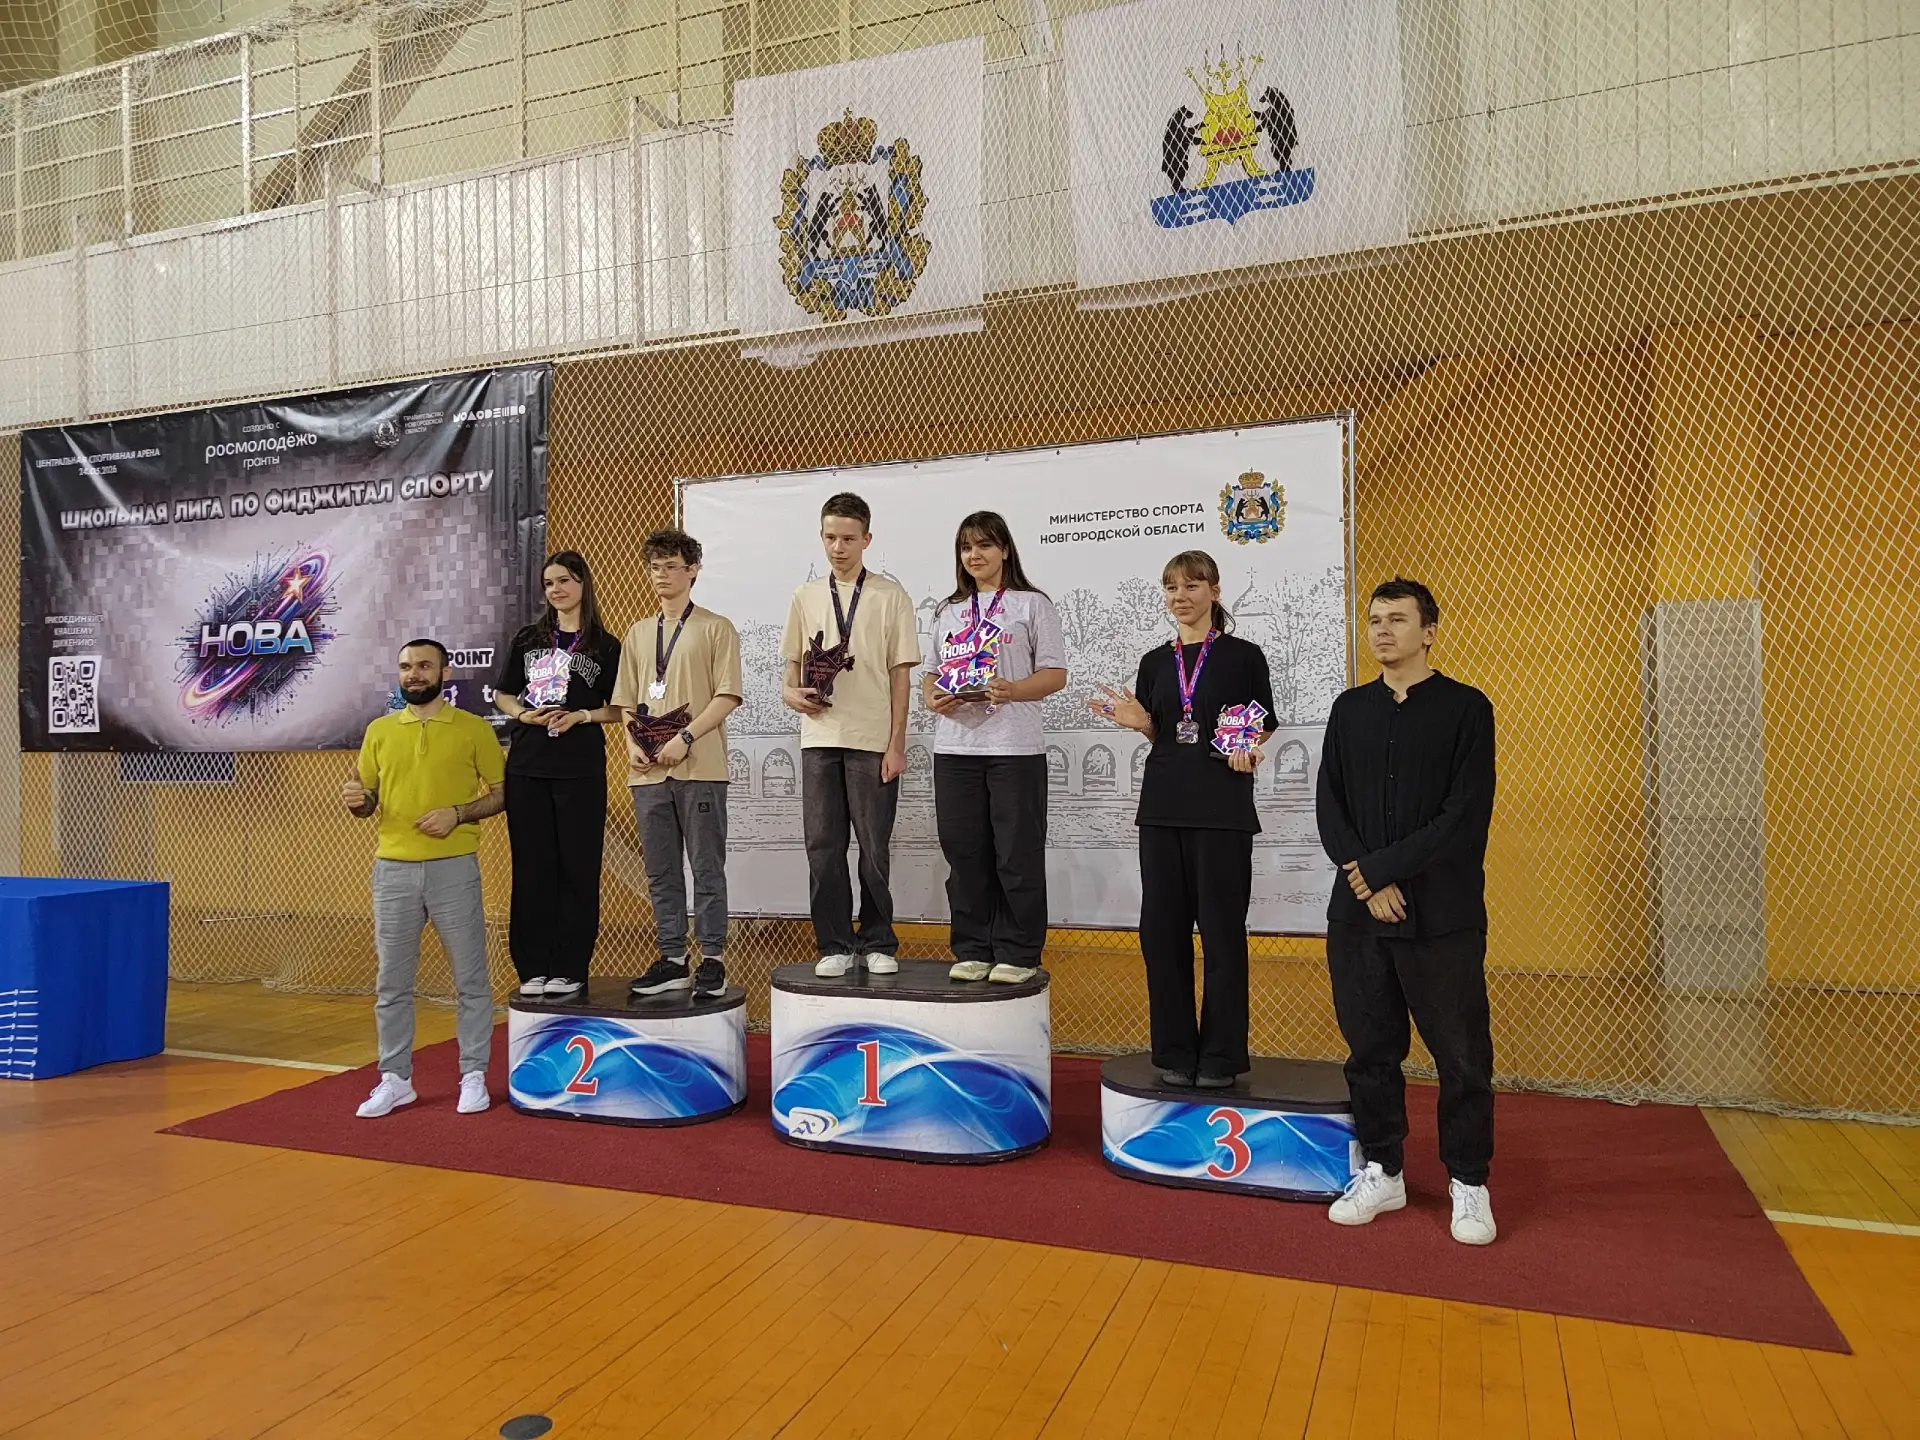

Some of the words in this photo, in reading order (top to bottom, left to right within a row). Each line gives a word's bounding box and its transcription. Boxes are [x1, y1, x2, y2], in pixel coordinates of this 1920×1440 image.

[242, 423, 274, 433] создано
[36, 455, 87, 468] ЦЕНТРАЛЬНАЯ
[88, 450, 136, 464] СПОРТИВНАЯ
[136, 447, 160, 459] АРЕНА
[205, 432, 318, 464] росмолодёжь
[243, 455, 280, 470] гранты
[60, 502, 169, 530] ШКОЛЬНАЯ
[173, 496, 225, 524] ЛИГА
[230, 491, 260, 517] ПО
[264, 479, 395, 514] ФИДЖИТАЛ
[401, 469, 494, 499] СПОРТУ
[1049, 507, 1149, 526] МИНИСТЕРСТВО
[1152, 502, 1205, 517] СПОРТА
[1040, 525, 1140, 545] НОВГОРОДСКОЙ
[1144, 521, 1205, 537] ОБЛАСТИ
[199, 619, 314, 658] НОВА
[943, 641, 976, 659] НОВА
[1220, 716, 1246, 727] НОВА
[565, 1034, 599, 1096] 2
[857, 1039, 887, 1107] 1
[1206, 1106, 1251, 1180] 3
